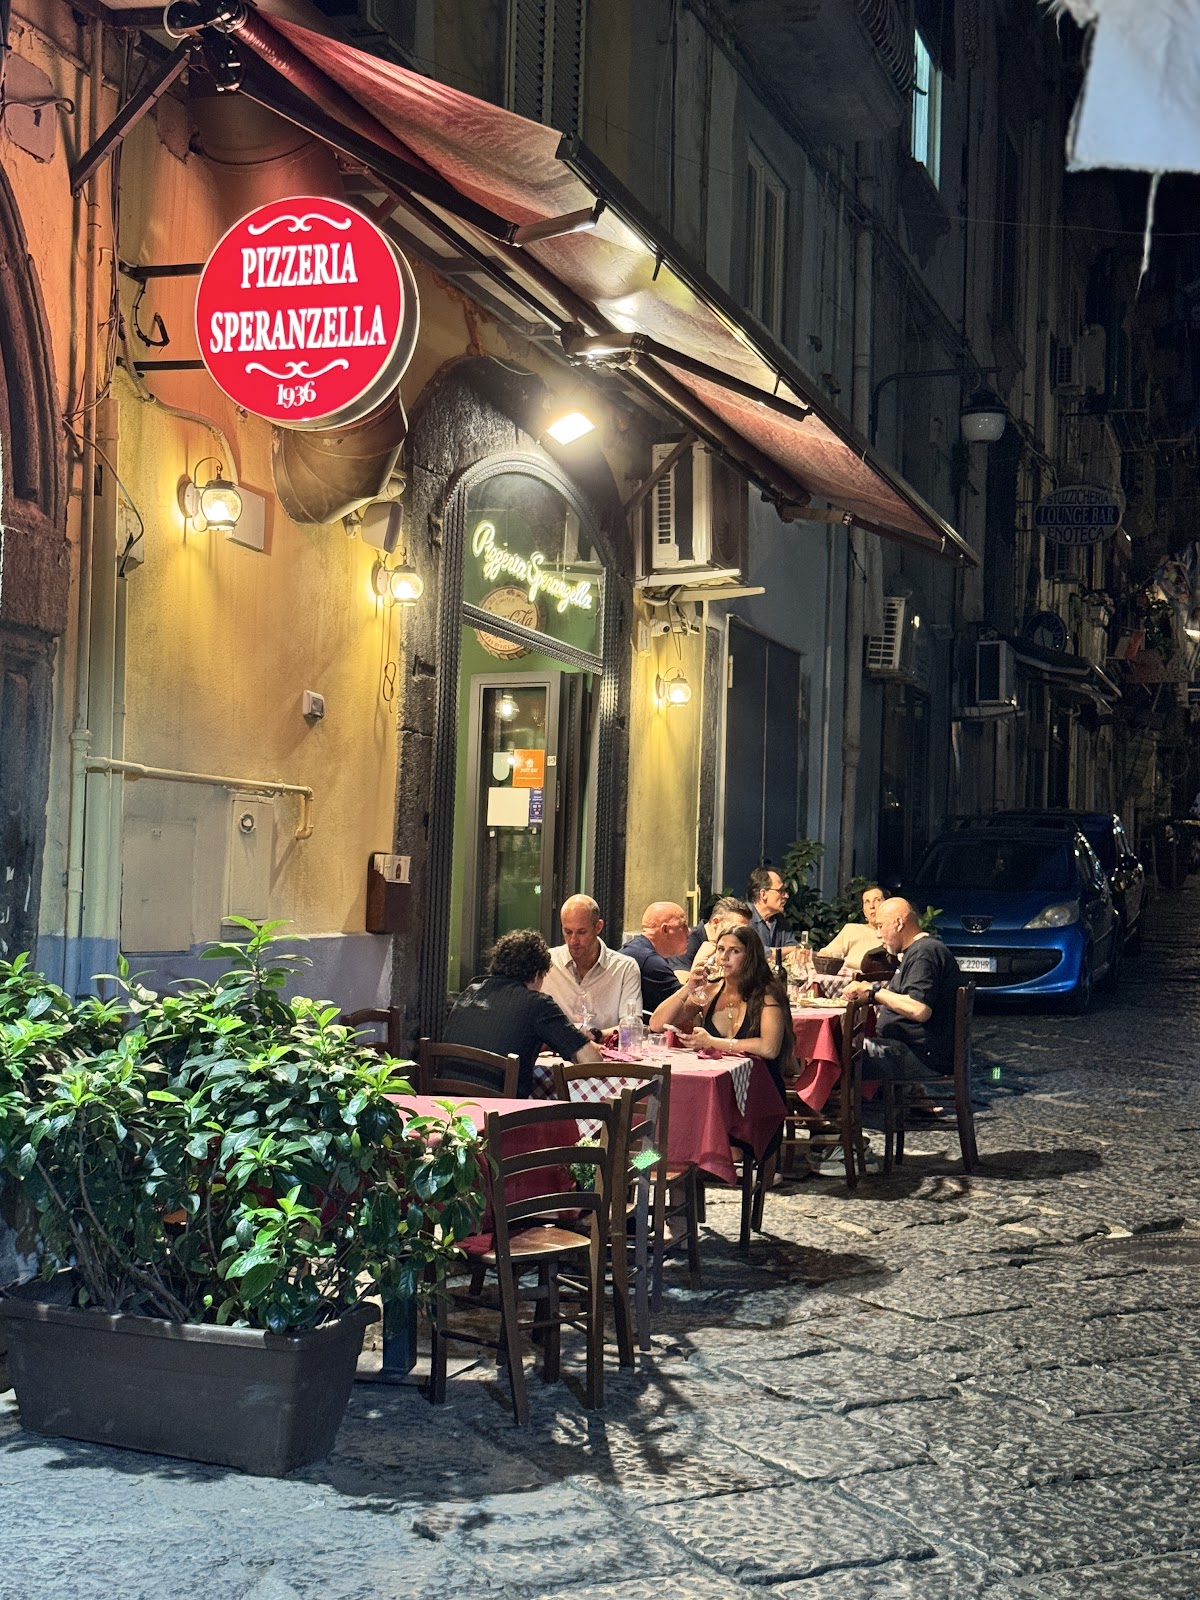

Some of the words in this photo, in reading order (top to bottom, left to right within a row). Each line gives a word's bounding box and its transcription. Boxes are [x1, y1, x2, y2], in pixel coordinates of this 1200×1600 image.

[241, 242, 358, 288] PIZZERIA
[210, 304, 387, 353] SPERANZELLA
[276, 381, 316, 408] 1936
[1041, 507, 1089, 524] LOUNGE
[1092, 507, 1115, 524] BAR
[1047, 526, 1104, 543] ENOTECA
